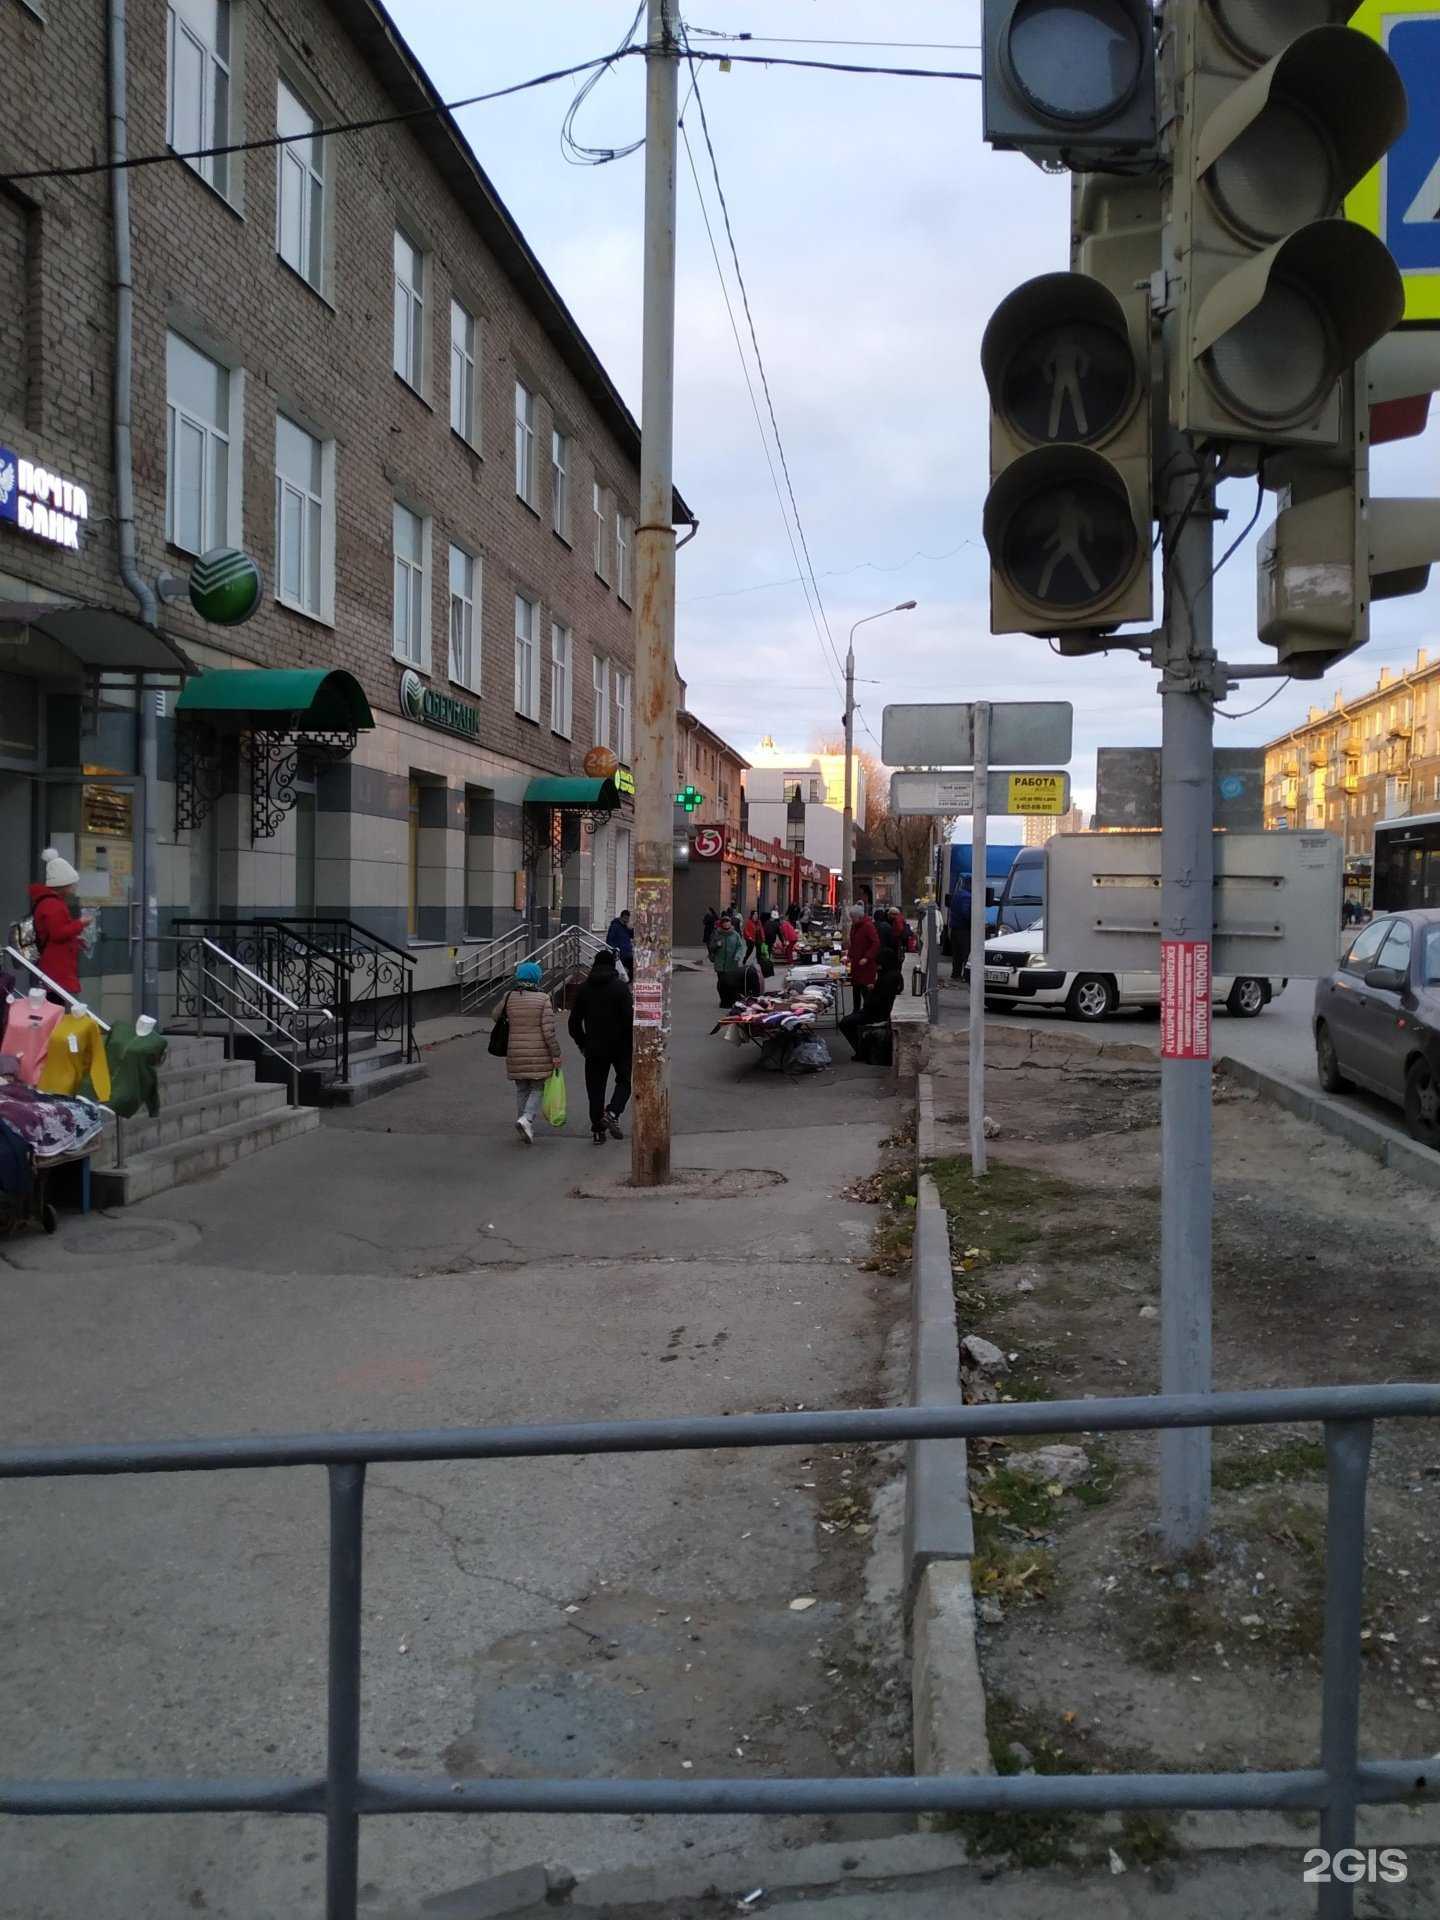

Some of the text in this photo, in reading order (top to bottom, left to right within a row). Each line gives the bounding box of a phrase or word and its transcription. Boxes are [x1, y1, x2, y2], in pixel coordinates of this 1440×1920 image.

[17, 458, 88, 520] ПОЧТА
[17, 495, 79, 550] БАНК
[424, 689, 480, 735] СБЕРБАНК
[1014, 777, 1056, 787] РАБОТА
[1166, 945, 1176, 1054] ЕЖЕДНЕВНЫЕ ВЫПЛАТЫ
[1195, 944, 1208, 1055] ПОМОЩЬ ЛЮДЯМ!!!
